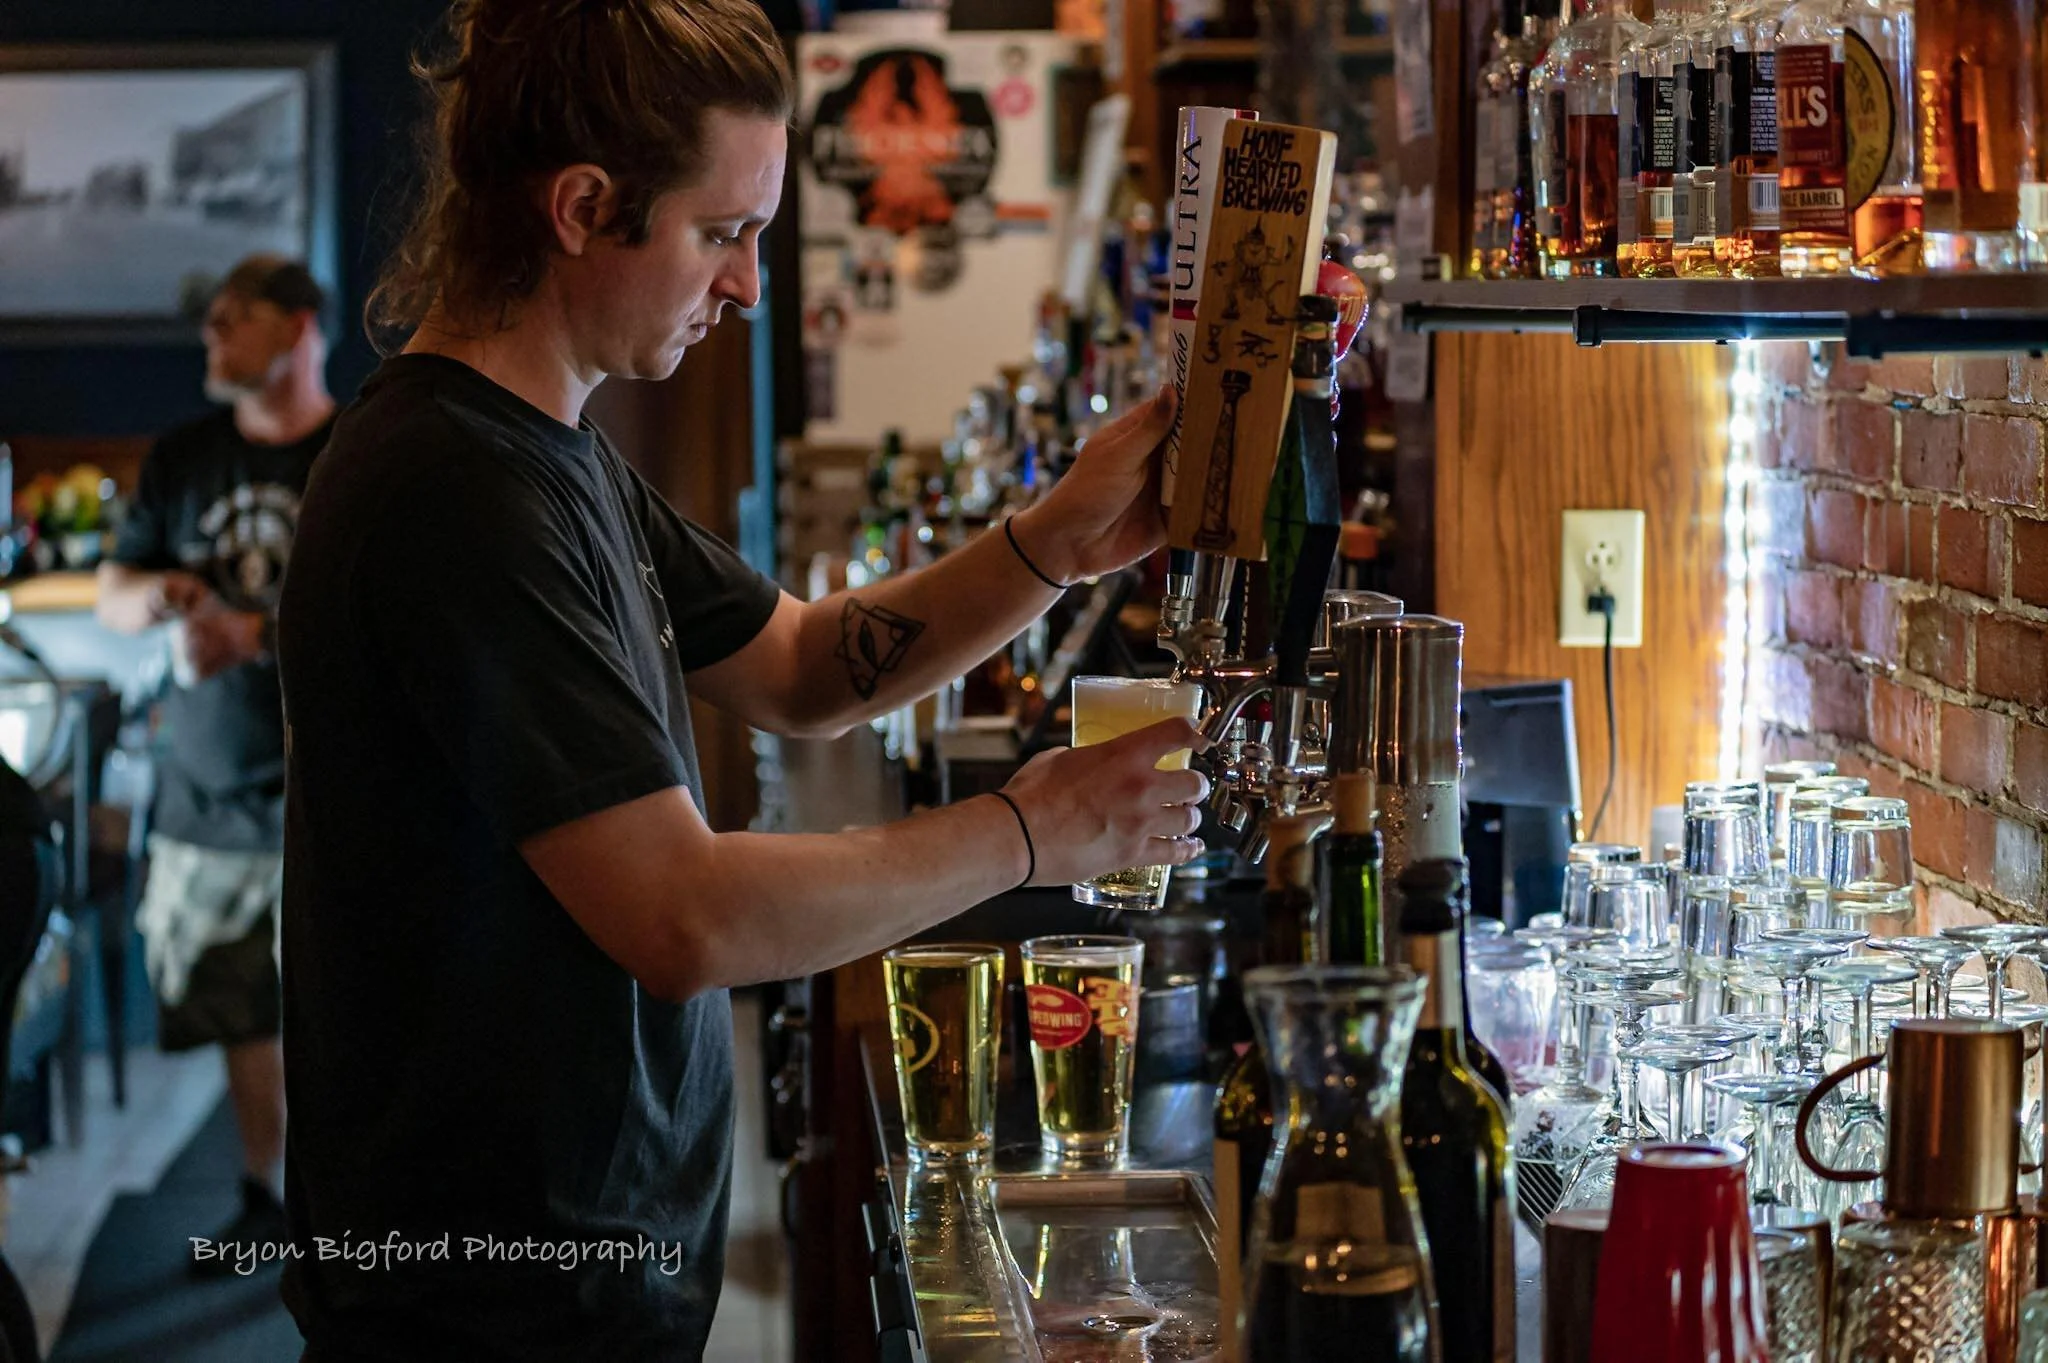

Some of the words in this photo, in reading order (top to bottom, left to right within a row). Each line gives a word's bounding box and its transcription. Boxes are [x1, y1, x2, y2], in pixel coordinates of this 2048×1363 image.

[1240, 126, 1295, 162] HOOF
[1223, 147, 1302, 188] HEARTED
[1174, 136, 1202, 292] ULTRA
[1222, 177, 1308, 216] BREWING
